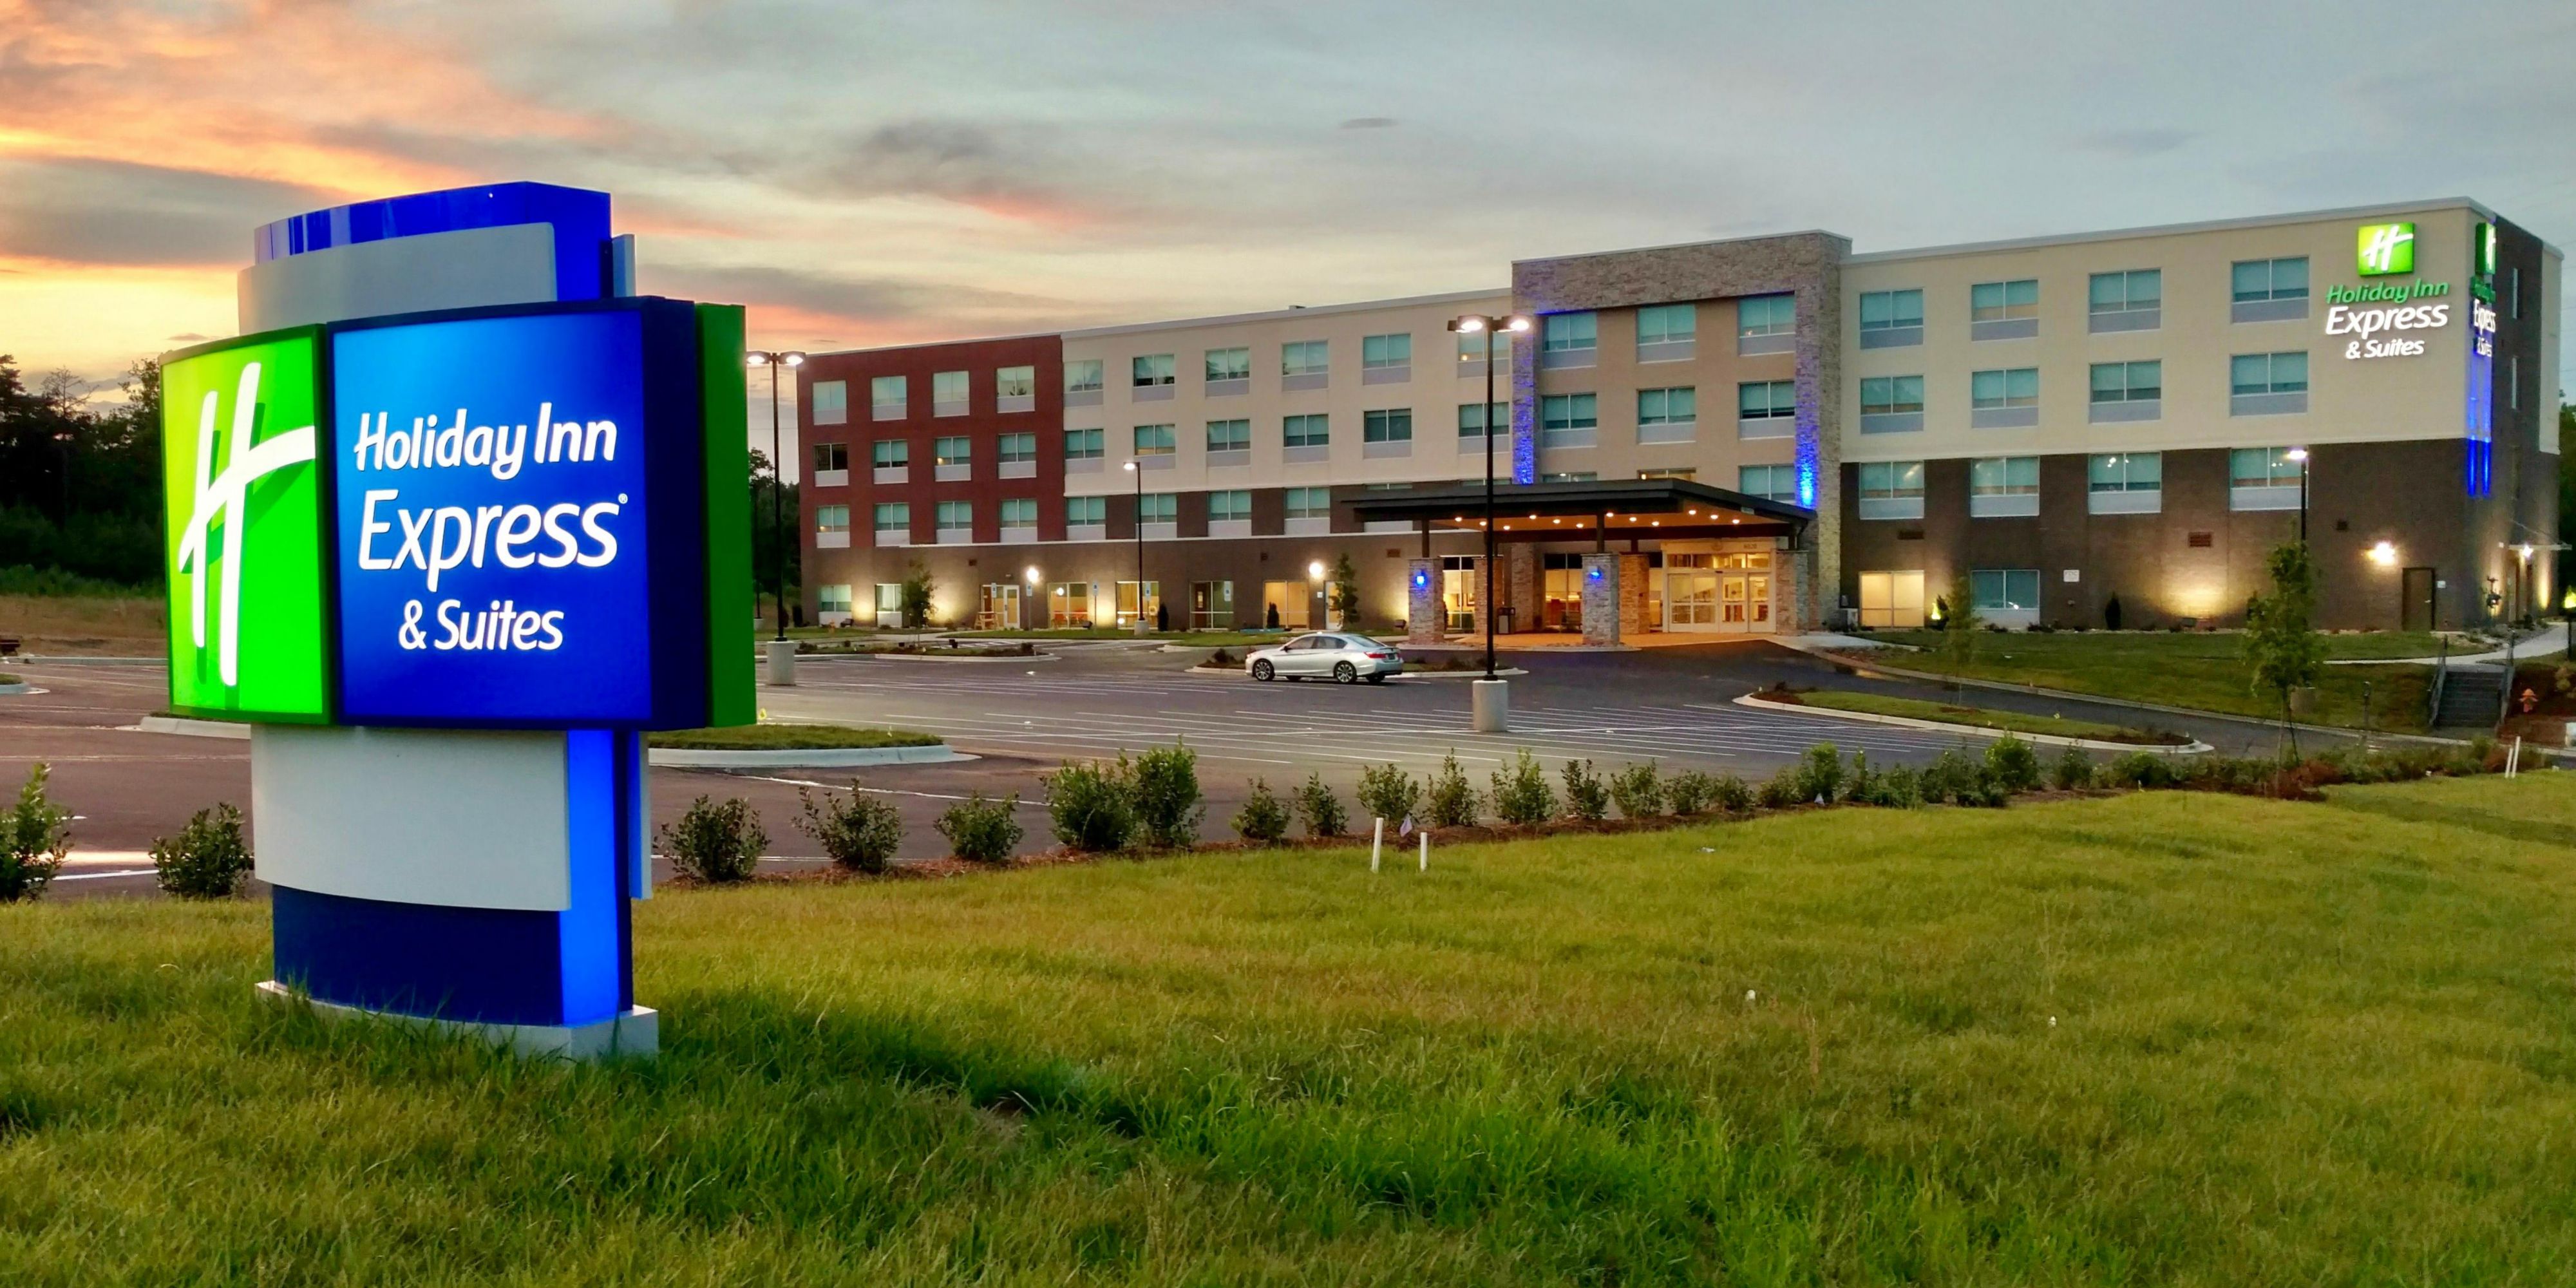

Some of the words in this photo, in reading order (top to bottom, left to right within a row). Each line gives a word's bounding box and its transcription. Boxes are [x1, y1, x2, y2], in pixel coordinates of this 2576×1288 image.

[2325, 281, 2410, 305] Holiday
[2413, 278, 2450, 298] Inn
[2325, 305, 2450, 340] Express
[2345, 341, 2361, 359] &
[2363, 338, 2425, 358] Suites
[354, 408, 527, 480] Holiday
[534, 402, 617, 464] Inn
[359, 489, 620, 592] Express
[399, 600, 426, 650] &
[434, 599, 564, 650] Suites
